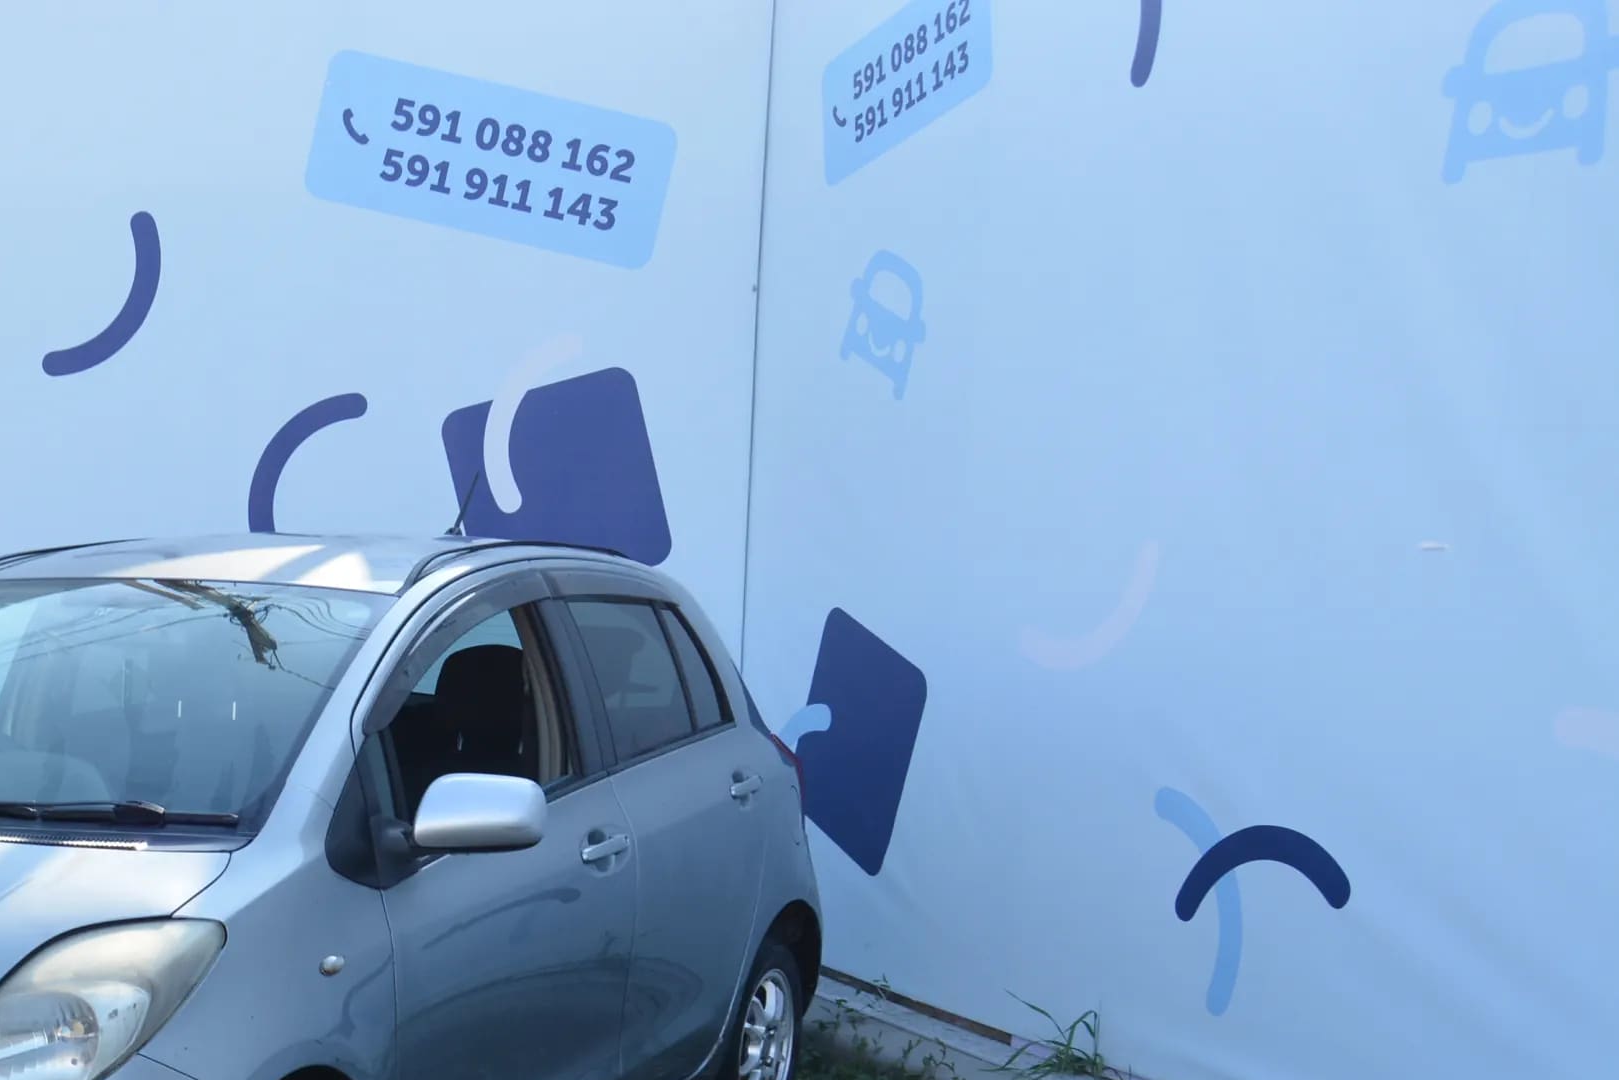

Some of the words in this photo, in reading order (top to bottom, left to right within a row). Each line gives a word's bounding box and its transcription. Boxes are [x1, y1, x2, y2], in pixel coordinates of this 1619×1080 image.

[853, 54, 886, 100] 591
[891, 24, 928, 72] 088
[934, 0, 971, 44] 162
[855, 98, 888, 143] 591
[892, 72, 927, 118] 911
[932, 40, 969, 92] 143
[390, 97, 462, 144] 591
[475, 117, 553, 163] 088
[561, 138, 636, 184] 162
[379, 148, 451, 195] 591
[463, 167, 532, 213] 911
[543, 186, 619, 231] 143
